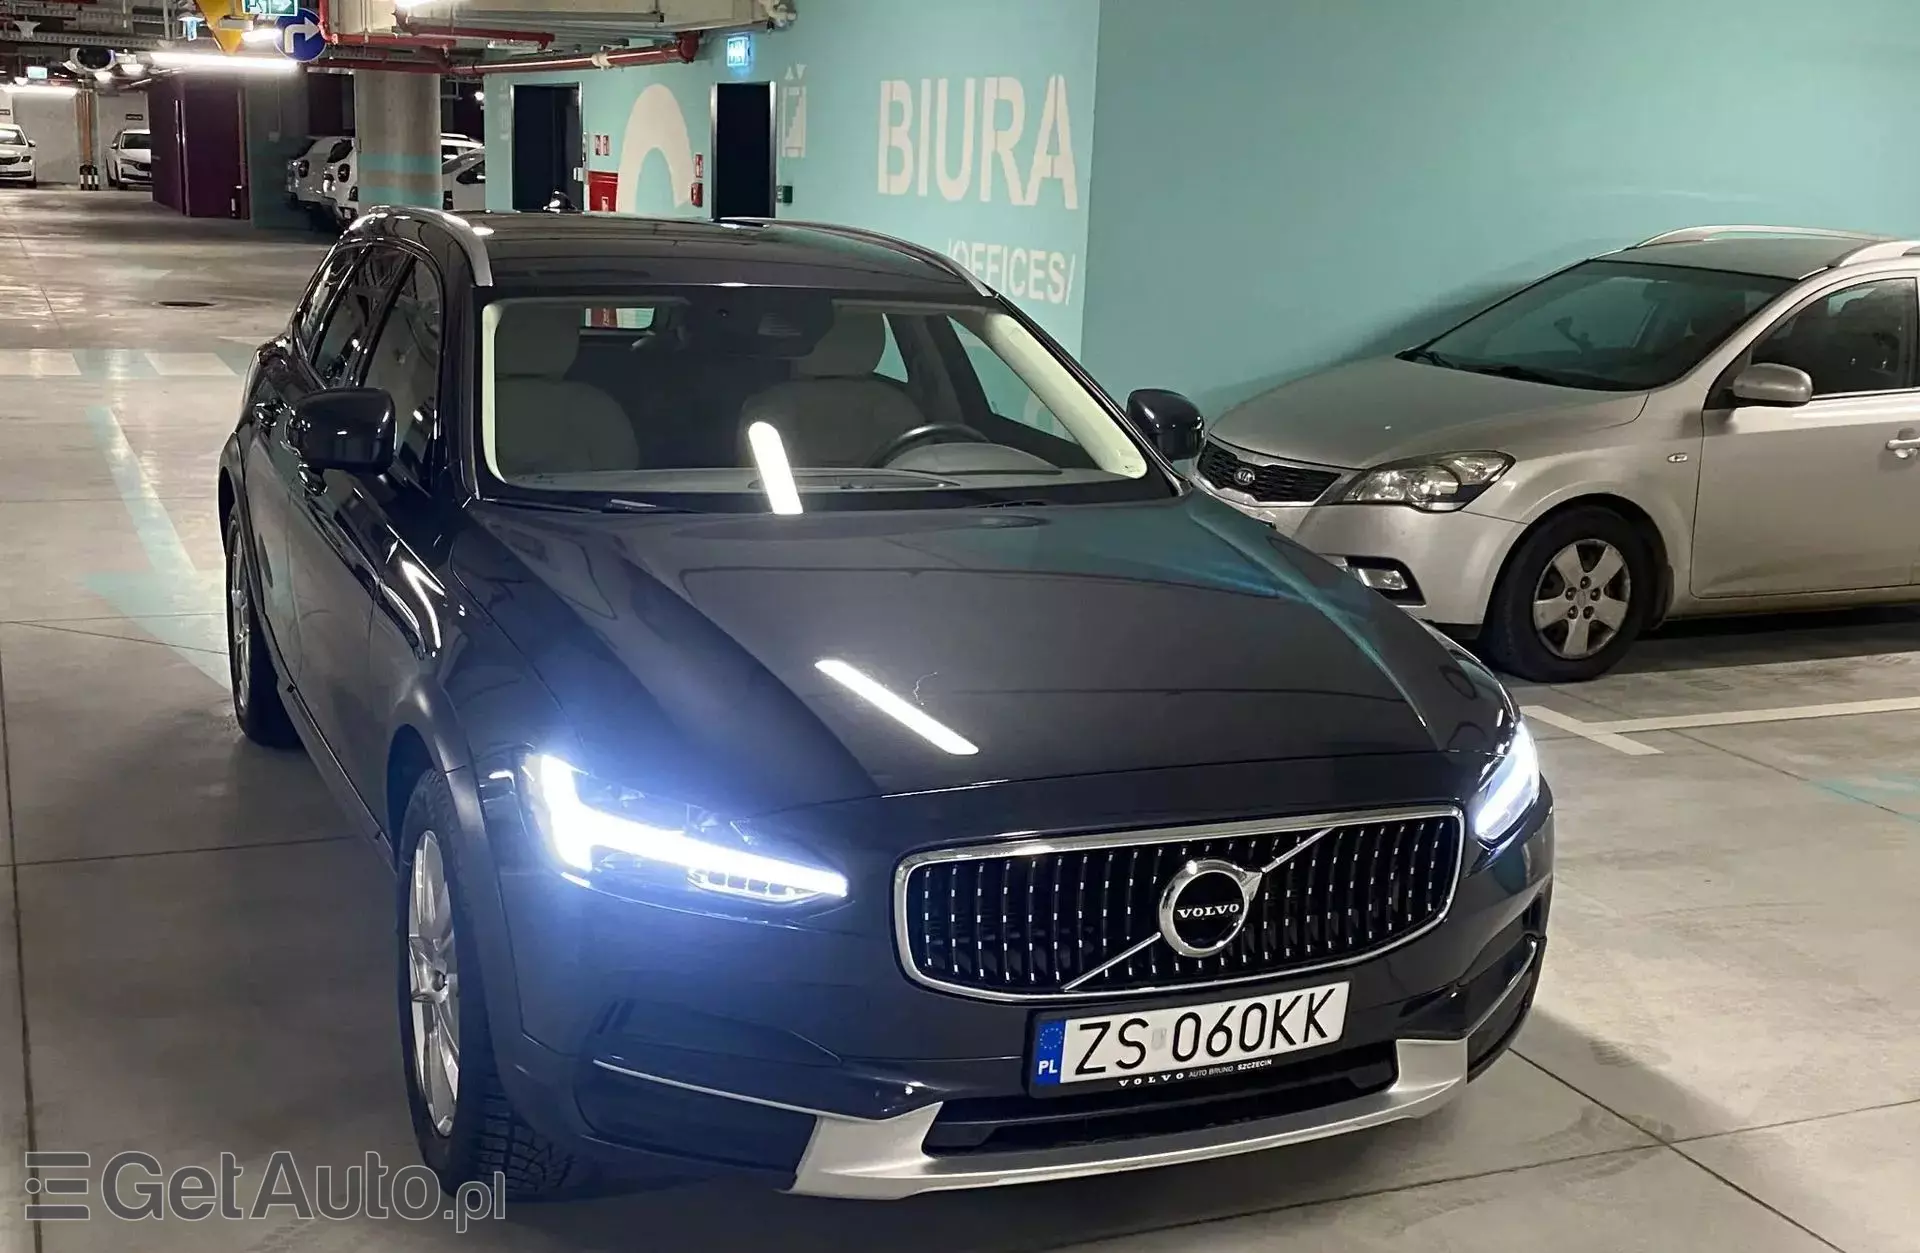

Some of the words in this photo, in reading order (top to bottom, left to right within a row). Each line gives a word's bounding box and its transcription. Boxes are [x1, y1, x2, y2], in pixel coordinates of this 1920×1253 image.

[877, 73, 1079, 210] BIURA
[1176, 903, 1240, 919] VOLVO
[1074, 1018, 1150, 1076] ZS
[1171, 988, 1336, 1064] 060KK
[1037, 1060, 1058, 1075] PL
[1118, 1073, 1185, 1087] VOLVO
[1188, 1068, 1208, 1079] AUTO
[1208, 1065, 1234, 1076] BRUNO
[1237, 1058, 1273, 1072] SZCZECIN
